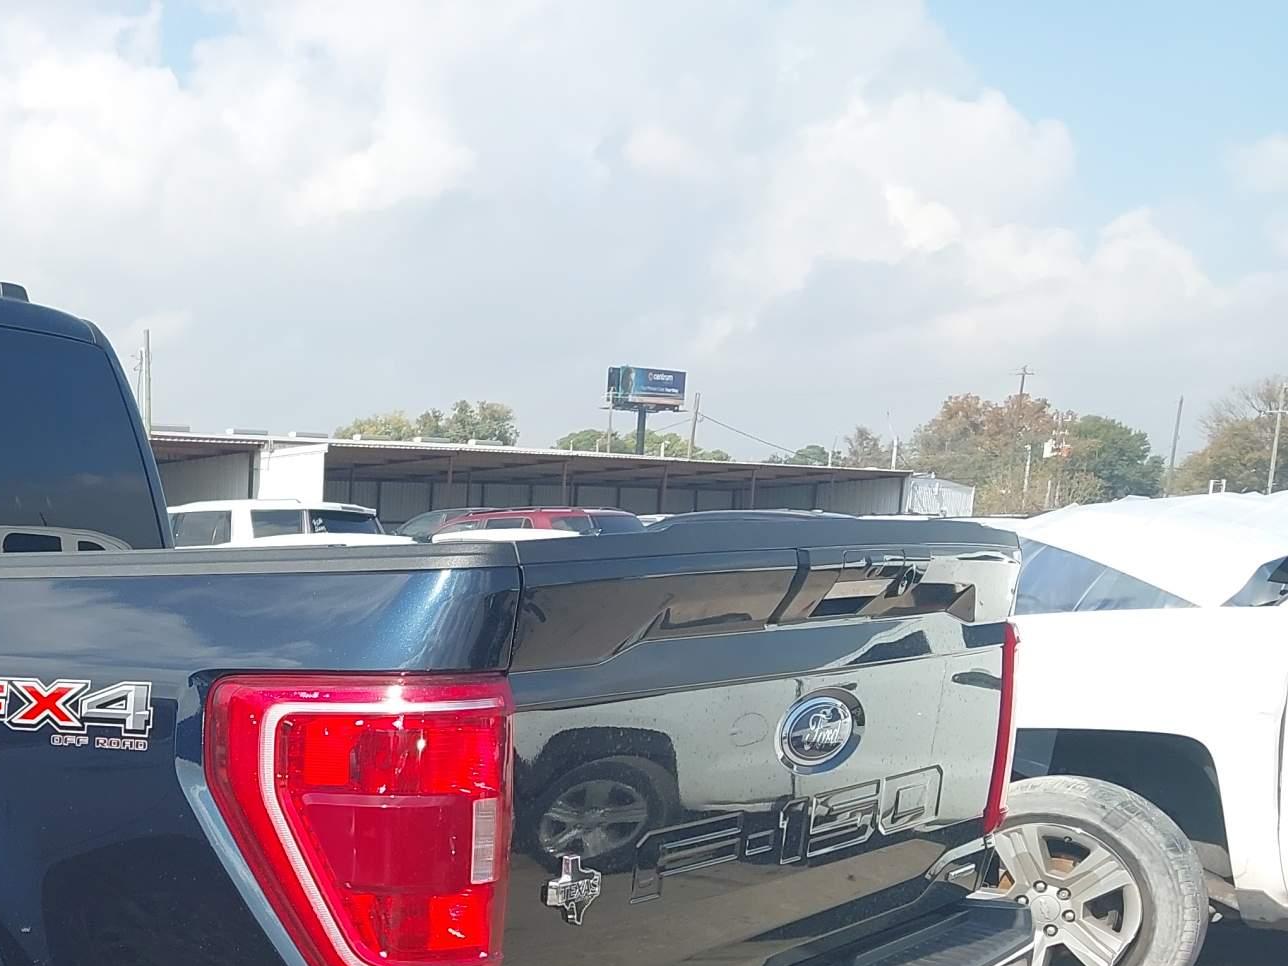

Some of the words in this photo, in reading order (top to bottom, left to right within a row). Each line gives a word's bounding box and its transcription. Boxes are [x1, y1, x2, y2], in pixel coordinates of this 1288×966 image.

[50, 734, 89, 747] OFF
[95, 736, 148, 751] ROAD
[802, 706, 842, 751] Ford
[630, 765, 944, 904] F-150
[559, 877, 599, 903] TEXAS
